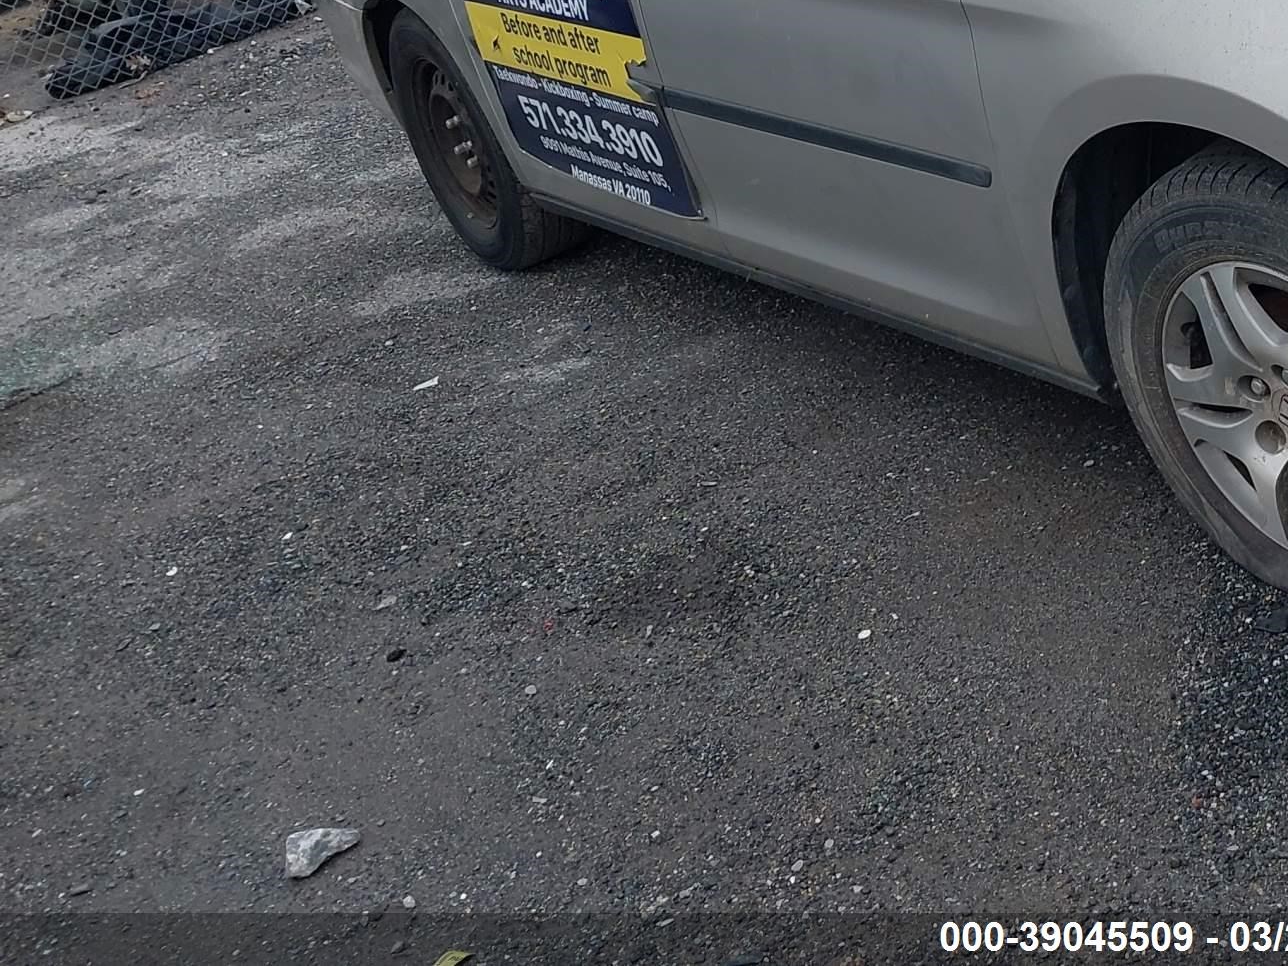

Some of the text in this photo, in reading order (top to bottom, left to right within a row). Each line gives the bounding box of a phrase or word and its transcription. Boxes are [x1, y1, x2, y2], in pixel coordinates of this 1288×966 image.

[500, 12, 600, 55] Before and after
[513, 42, 611, 88] school program
[493, 65, 538, 90] Taekwondo
[540, 78, 591, 108] Kickboxing
[594, 92, 633, 116] Summer
[633, 104, 660, 127] camp
[517, 93, 664, 167] 571.334.3910
[560, 141, 591, 162] Mathis
[622, 161, 650, 183] Suite
[570, 163, 652, 206] Manassas VA 20110
